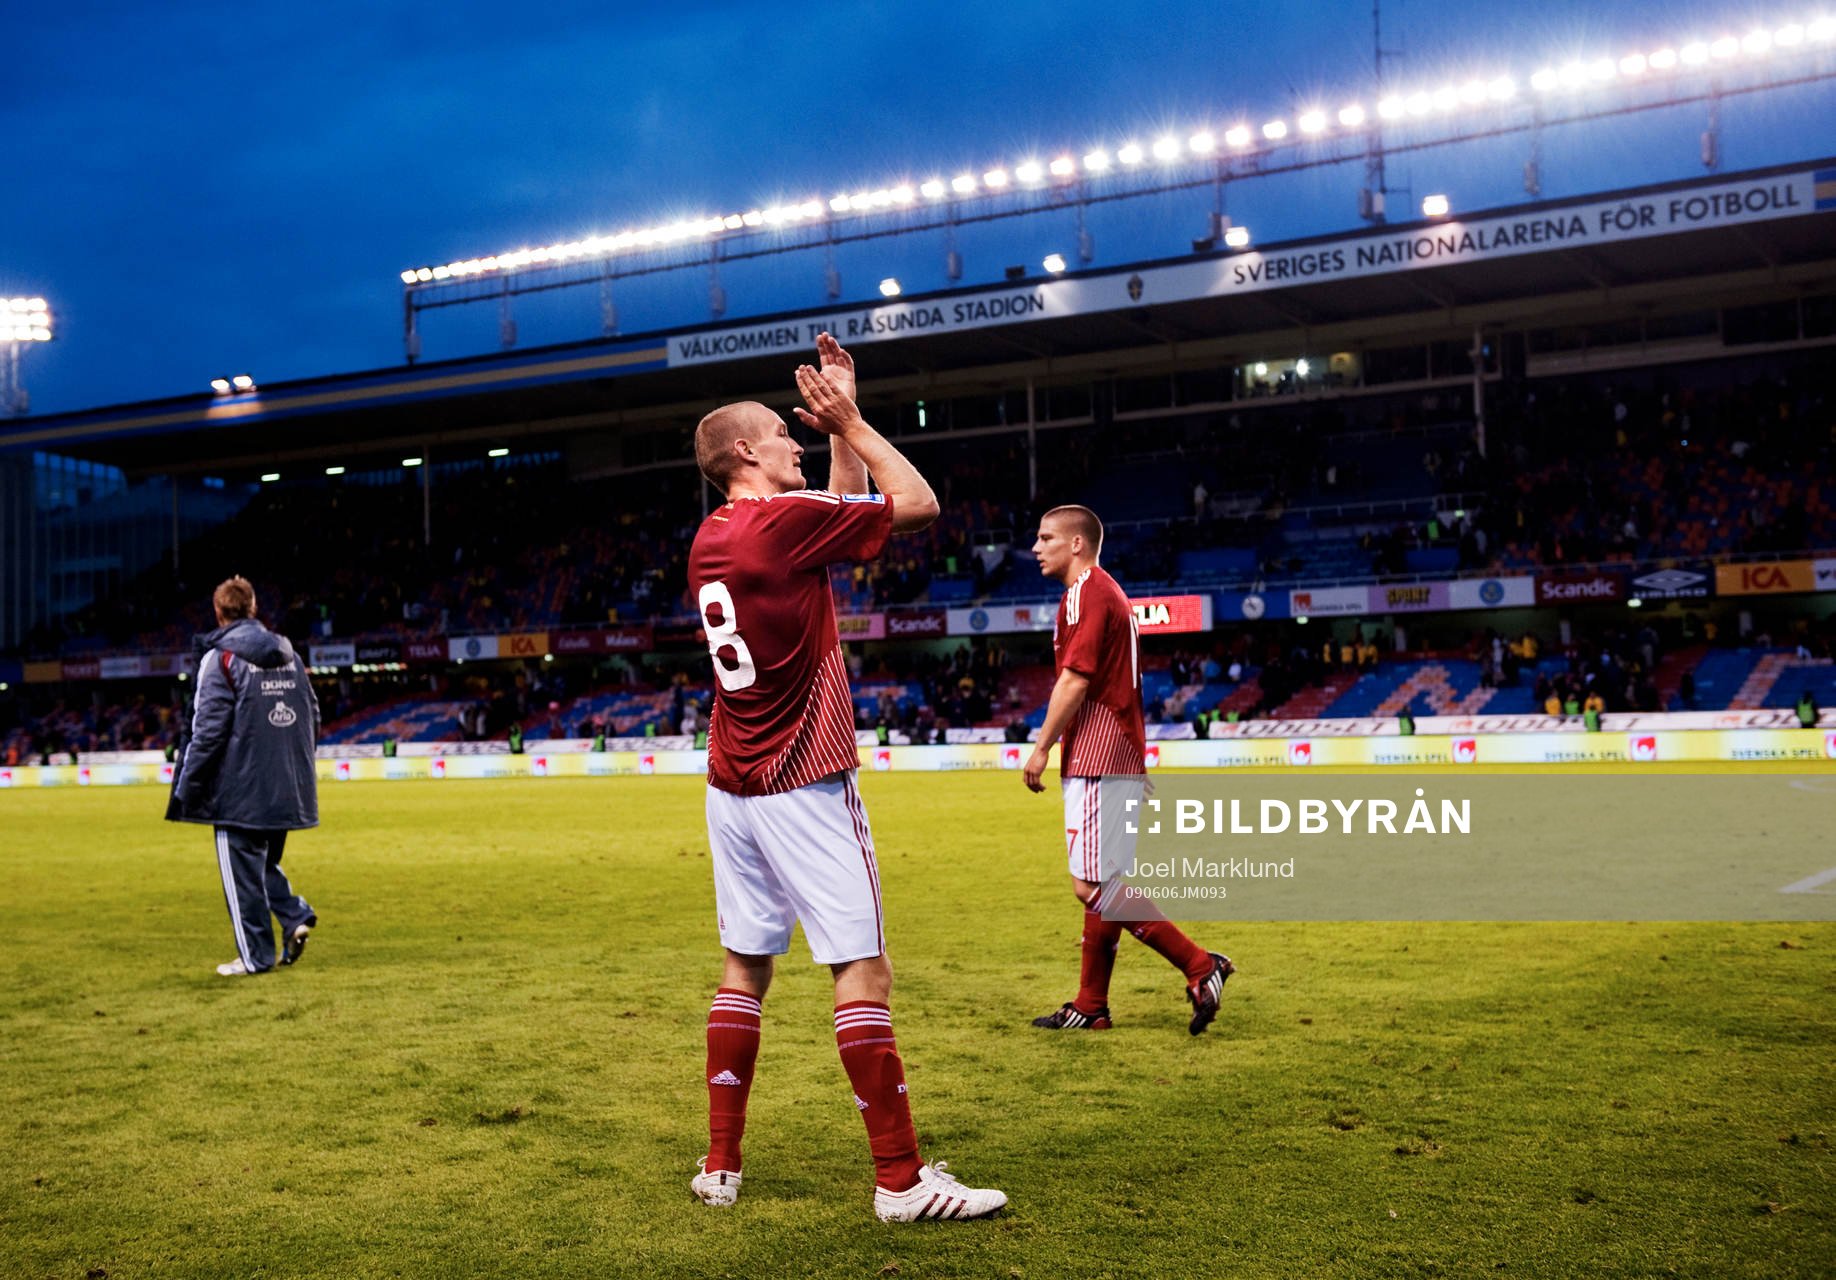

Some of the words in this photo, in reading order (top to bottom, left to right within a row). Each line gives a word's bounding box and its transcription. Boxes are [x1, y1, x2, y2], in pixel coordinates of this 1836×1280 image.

[1233, 247, 1345, 285] SVERIGES
[1357, 214, 1587, 268] NATIONALARENA
[1600, 201, 1656, 231] FÖR
[1669, 184, 1799, 223] FOTBOLL
[679, 326, 799, 359] VÄLKOMMEN
[808, 323, 840, 342] TILL
[847, 306, 945, 337] RÅSUNDA
[954, 293, 1045, 323] STADION
[1542, 579, 1616, 598] Scandic
[1742, 567, 1790, 590] ICA
[889, 613, 942, 634] Scandic
[510, 636, 537, 655] ICA
[699, 581, 756, 691] 8
[408, 645, 441, 658] TELIA
[261, 680, 296, 690] DONG
[272, 711, 292, 721] Arla
